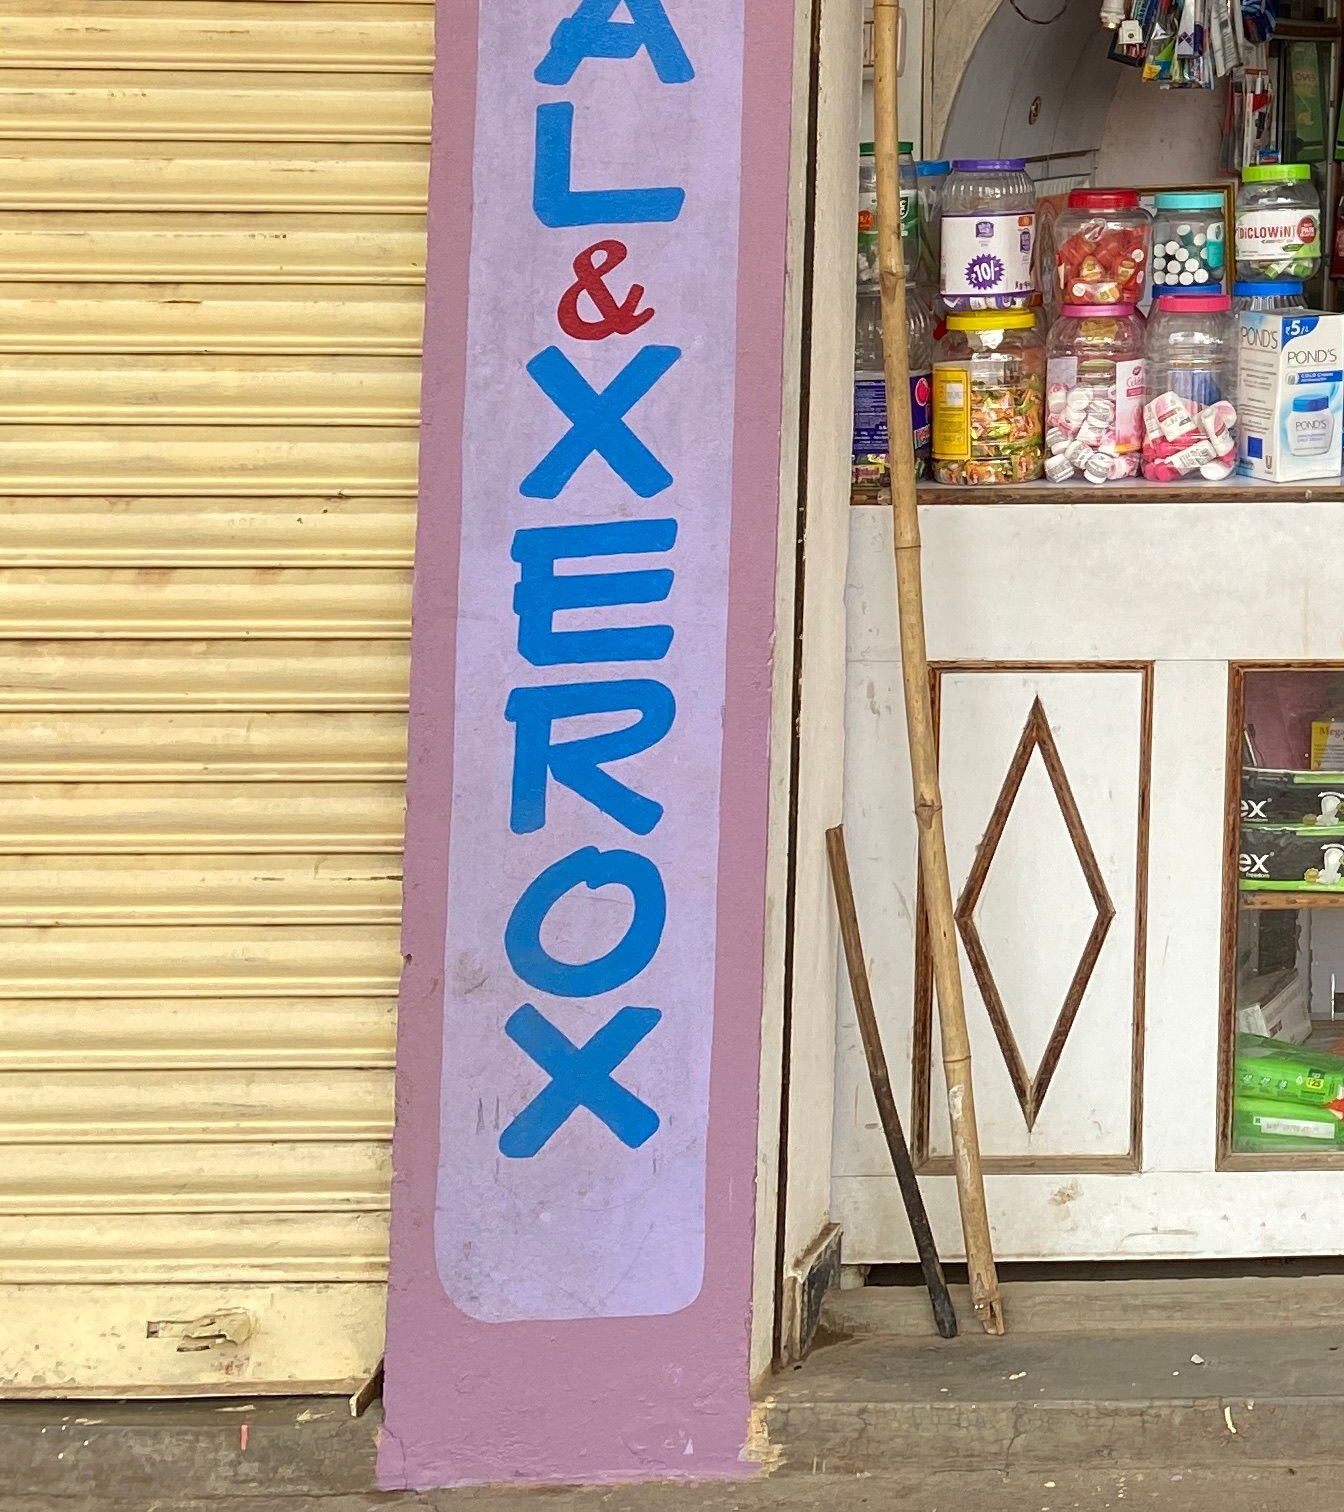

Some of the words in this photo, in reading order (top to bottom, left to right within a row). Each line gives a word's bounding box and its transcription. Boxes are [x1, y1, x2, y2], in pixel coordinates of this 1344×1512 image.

[556, 238, 656, 341] &
[1240, 326, 1279, 350] POND'S
[1287, 349, 1338, 364] POND'S
[1295, 420, 1328, 432] POND'S
[499, 343, 682, 1159] XEROX
